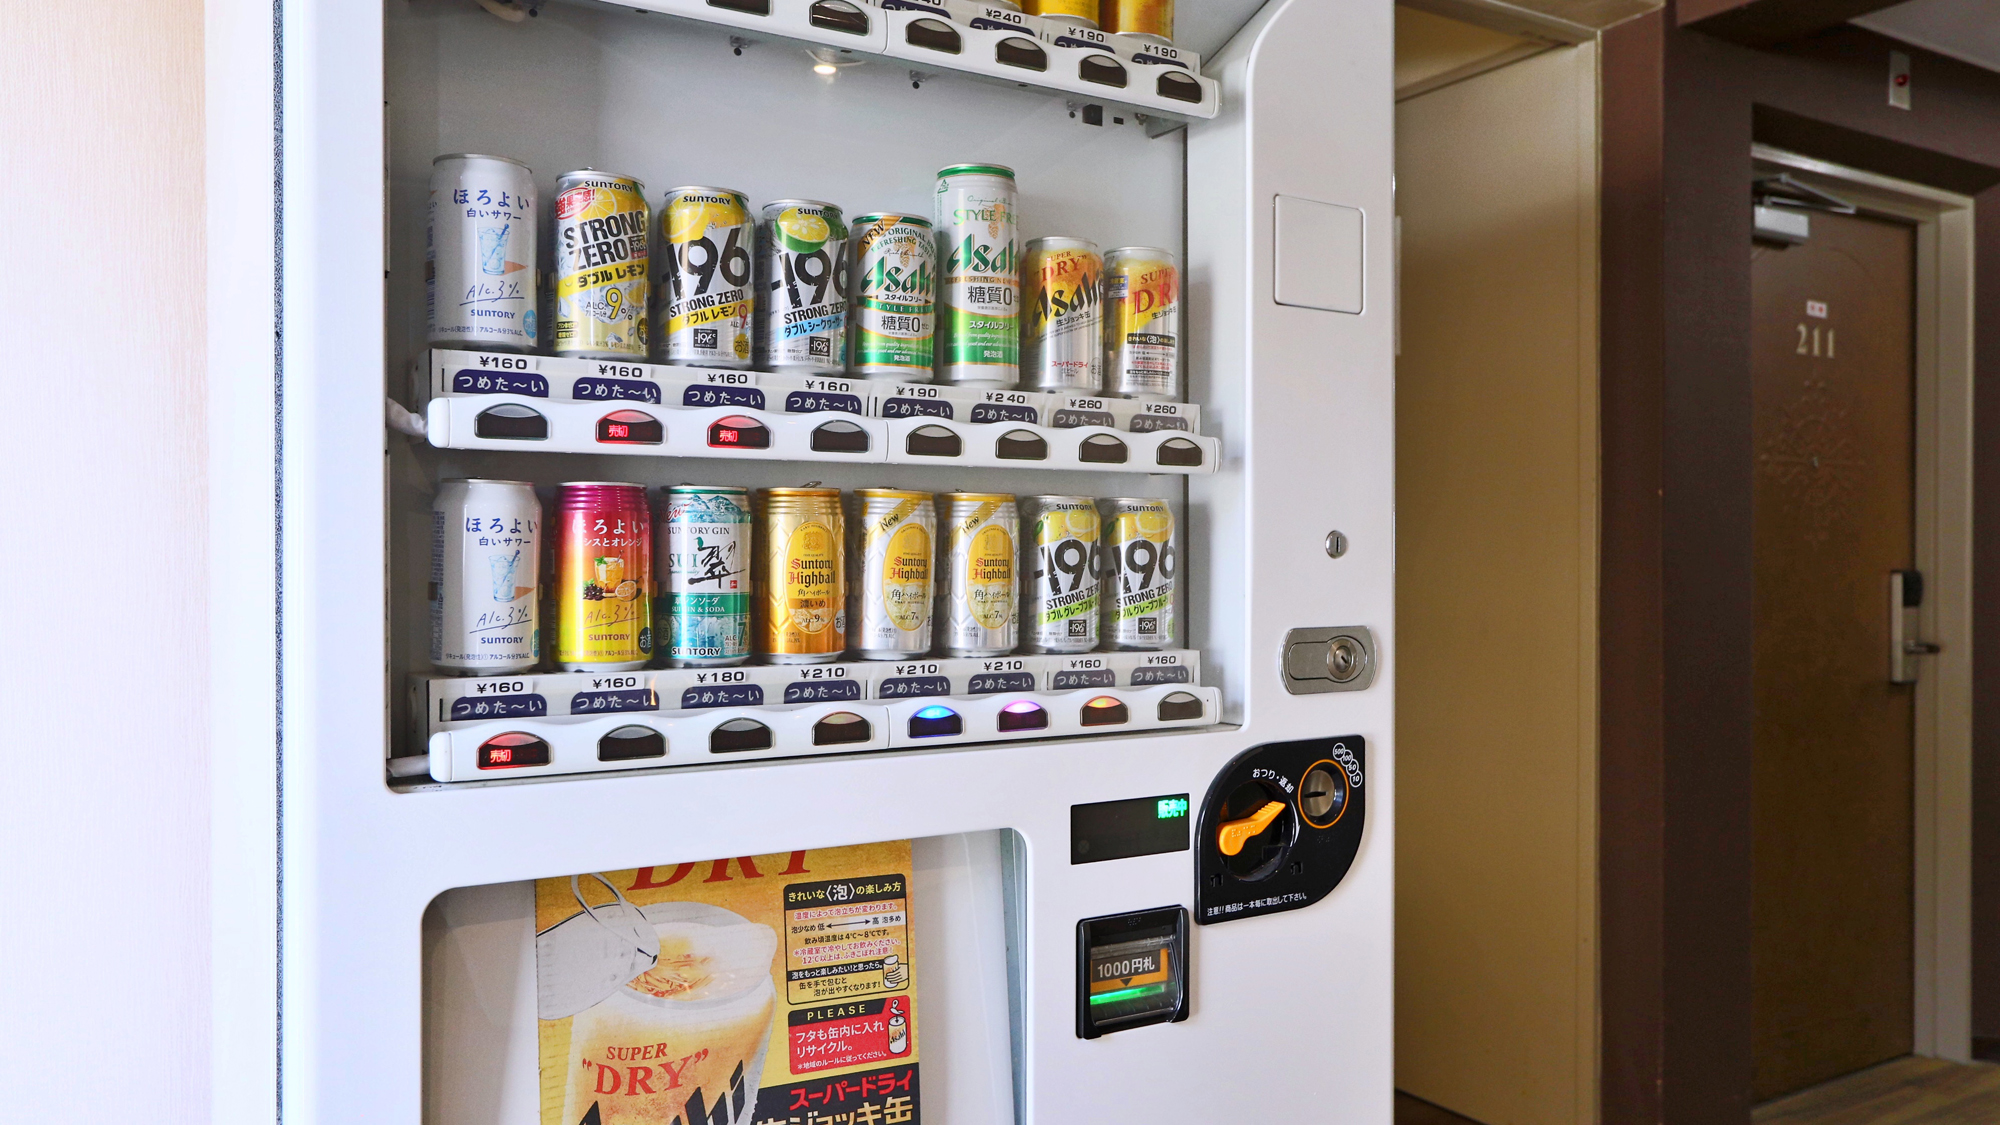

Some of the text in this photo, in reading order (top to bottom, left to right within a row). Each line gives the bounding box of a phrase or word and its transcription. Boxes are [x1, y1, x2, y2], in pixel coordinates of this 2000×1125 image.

[985, 8, 1022, 24] ¥240
[1067, 26, 1105, 43] ¥190
[1143, 43, 1178, 59] ¥190
[585, 181, 633, 192] SUNTORY
[453, 189, 529, 209] ほろよい
[683, 195, 731, 205] SUNTORY
[467, 208, 521, 220] 白いサワー
[953, 209, 997, 226] STYLE
[564, 210, 645, 249] STRONG
[862, 220, 885, 249] NEW
[888, 227, 926, 242] ORIGINAL
[568, 238, 629, 271] ZERO
[578, 264, 645, 288] ダブル レモン
[669, 289, 744, 318] STRONG ZERO
[884, 294, 922, 302] スタイルフリー
[711, 306, 736, 319] レモン
[784, 304, 829, 324] STRONG
[784, 323, 807, 338] ダブル
[969, 320, 1014, 331] スタイルフリー
[1796, 322, 1835, 359] 211
[479, 356, 527, 370] ¥160
[598, 365, 643, 378] ¥160
[707, 373, 748, 384] ¥160
[805, 380, 849, 392] ¥160
[896, 386, 937, 398] ¥190
[986, 392, 1026, 404] ¥240
[1070, 399, 1102, 410] ¥260
[1145, 404, 1177, 414] ¥260
[608, 425, 628, 438] 売切
[719, 430, 738, 443] 売切
[466, 517, 538, 533] ほろよい
[572, 519, 644, 534] ほろよい
[879, 514, 899, 531] New
[962, 517, 979, 534] New
[711, 527, 730, 535] GIN
[479, 537, 531, 546] 白いサワー
[578, 537, 643, 547] シスとオレンジ
[791, 558, 833, 571] Suntory
[894, 556, 928, 568] Suntory
[976, 558, 1009, 568] Suntory
[788, 571, 836, 588] Highball
[889, 568, 928, 582] Highball
[972, 568, 1010, 582] Highball
[800, 600, 826, 608] 濃いめ
[1046, 591, 1085, 610] STRONG
[1115, 589, 1155, 608] STRONG
[983, 660, 1023, 671] ¥210
[1070, 659, 1101, 668] ¥160
[1147, 655, 1177, 665] ¥160
[800, 667, 845, 679] ¥210
[896, 664, 938, 675] ¥210
[592, 677, 636, 689] ¥160
[697, 671, 745, 683] ¥180
[477, 681, 524, 694] ¥160
[490, 749, 511, 762] 売切
[1252, 768, 1294, 794] おつり・返却
[1157, 798, 1188, 819] 販売中
[791, 915, 902, 934] 泡少なめ 低 高 泡多め
[1097, 956, 1155, 978] 1000円札
[799, 976, 847, 990] 缶を手で包むと
[807, 1004, 866, 1020] PLEASE
[796, 1021, 884, 1044] フタも缶内に入れ
[606, 1042, 668, 1061] SUPER
[797, 1041, 852, 1058] リサイクル。
[789, 1069, 913, 1111] スーパードライ
